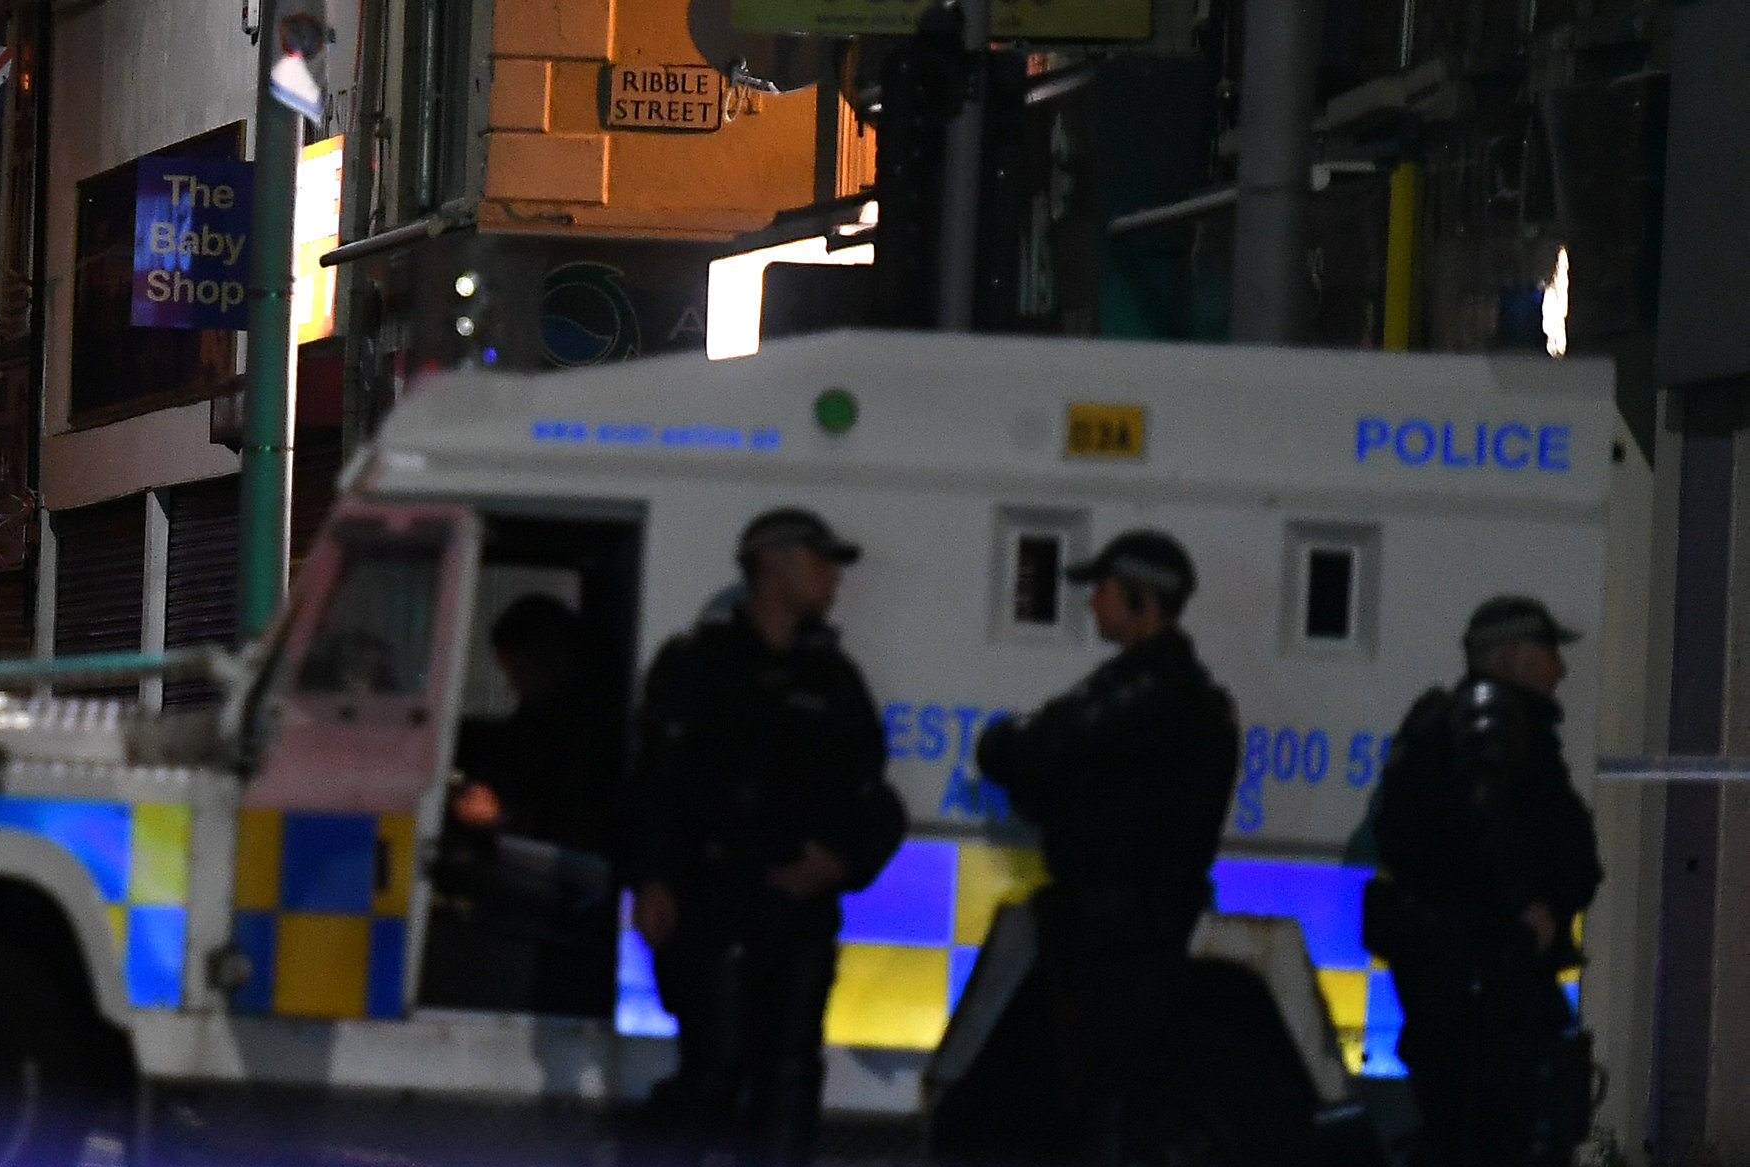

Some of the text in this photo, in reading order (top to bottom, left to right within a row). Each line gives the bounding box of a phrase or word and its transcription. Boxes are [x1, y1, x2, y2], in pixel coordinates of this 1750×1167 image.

[623, 71, 708, 95] RIBBLE
[615, 99, 713, 122] STREET
[163, 174, 235, 209] The
[151, 222, 247, 266] Baby
[146, 269, 245, 314] Shop
[1356, 415, 1571, 472] POLICE
